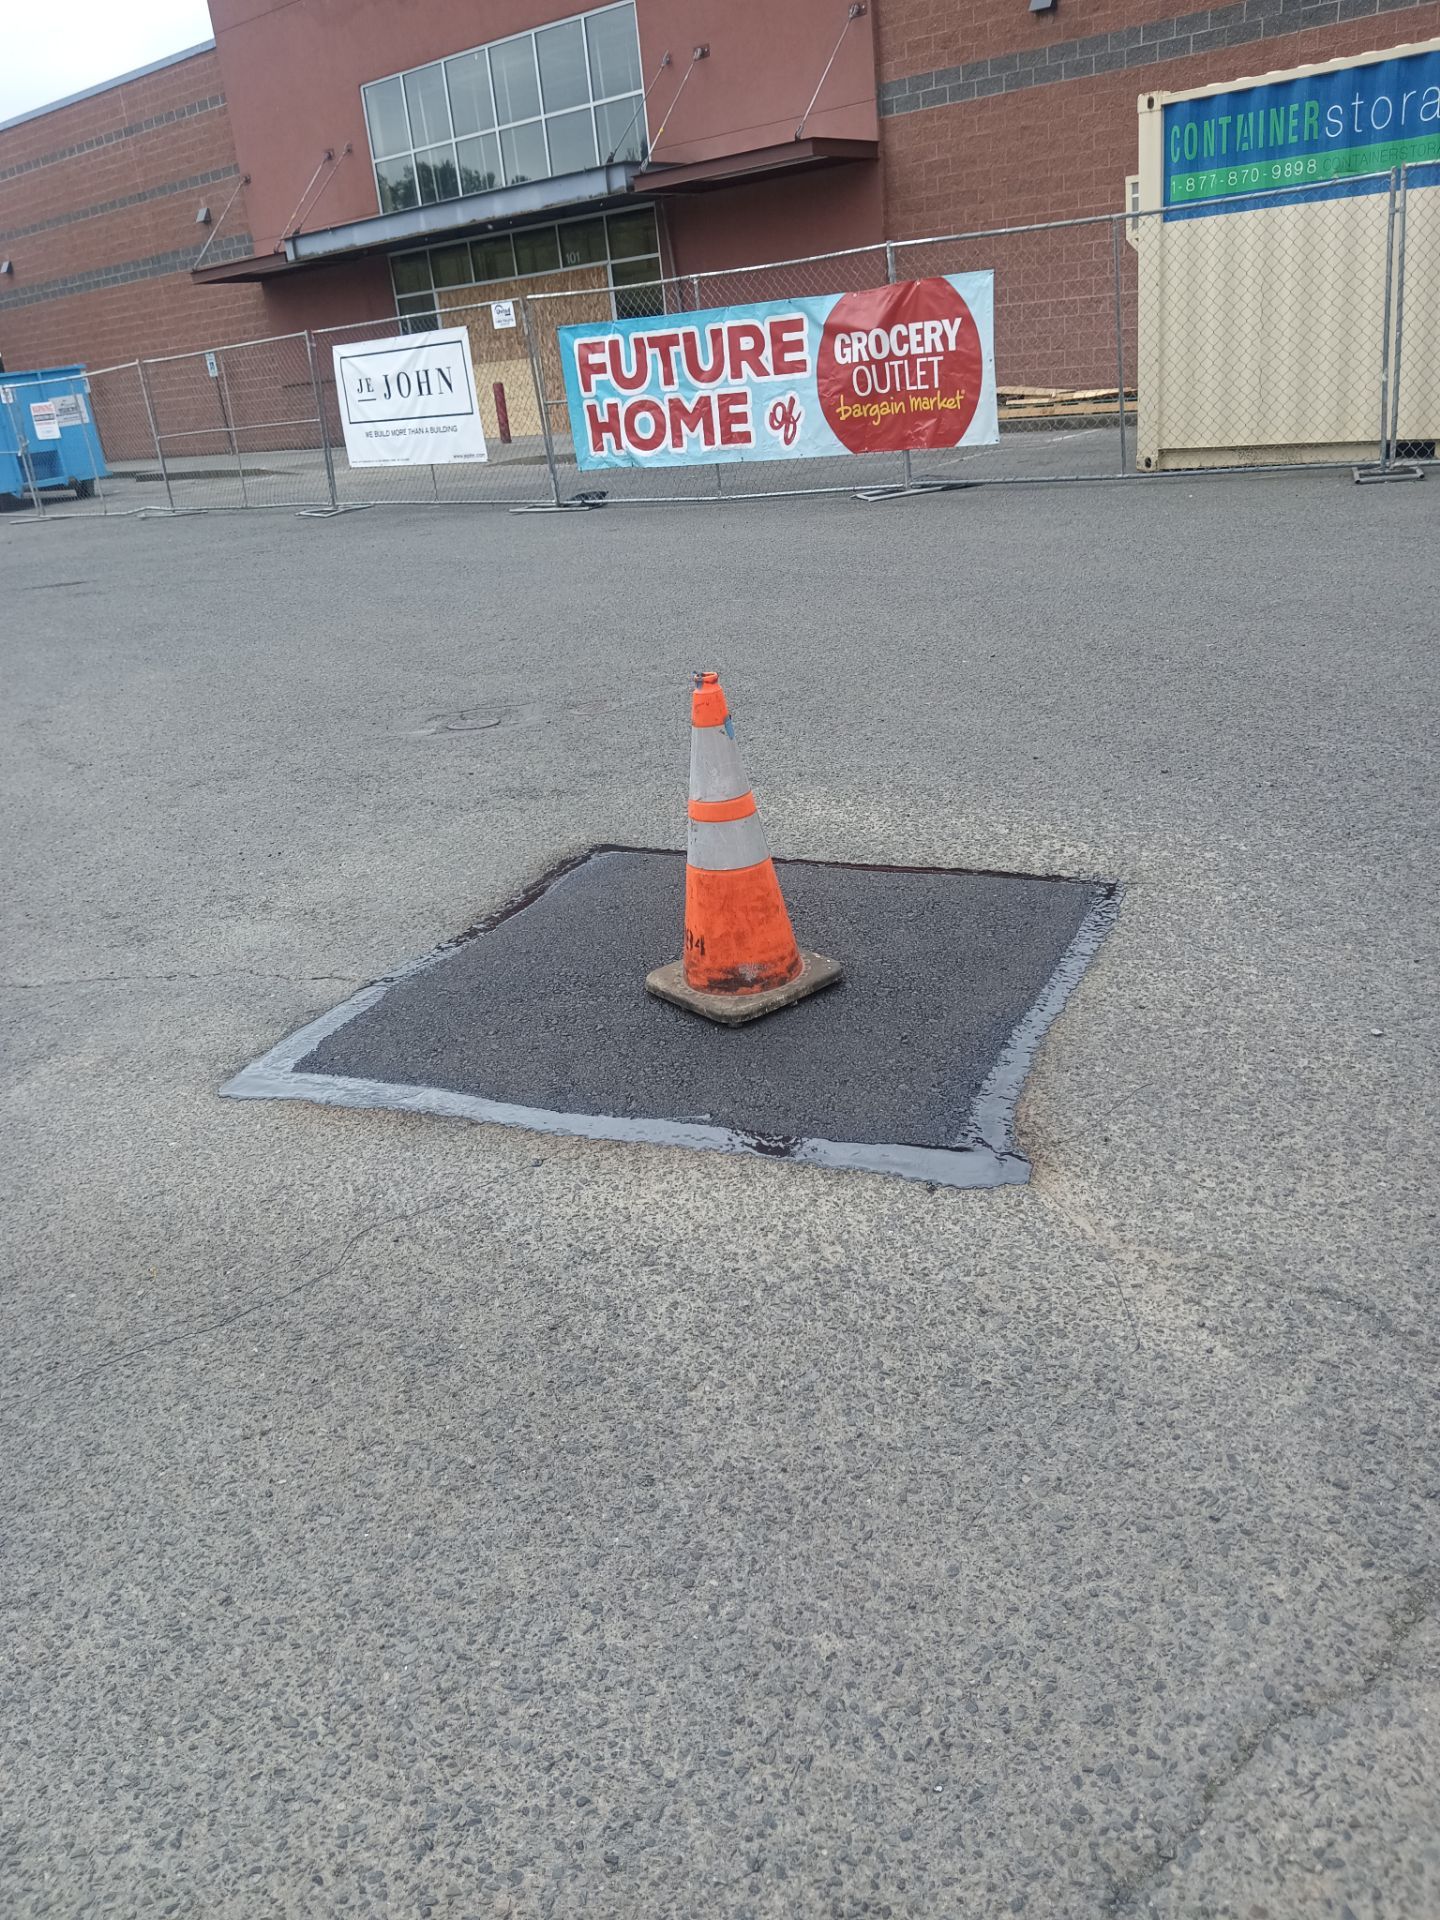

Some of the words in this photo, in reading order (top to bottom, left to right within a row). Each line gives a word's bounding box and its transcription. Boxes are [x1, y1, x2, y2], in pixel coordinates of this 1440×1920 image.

[1170, 100, 1319, 163] CONTAINER
[1171, 158, 1317, 195] 1-877-870-9898
[576, 315, 809, 395] FUTURE
[833, 317, 962, 365] GROCERY
[357, 377, 375, 394] JE
[382, 366, 453, 400] JOHN
[852, 355, 944, 397] OUTLET
[585, 389, 753, 454] HOME
[768, 394, 802, 446] of
[835, 394, 906, 426] bargain
[909, 389, 965, 412] market
[374, 429, 390, 438] BUILD
[391, 428, 407, 437] MORE
[408, 427, 424, 435] THAN
[430, 425, 458, 434] BUILDING
